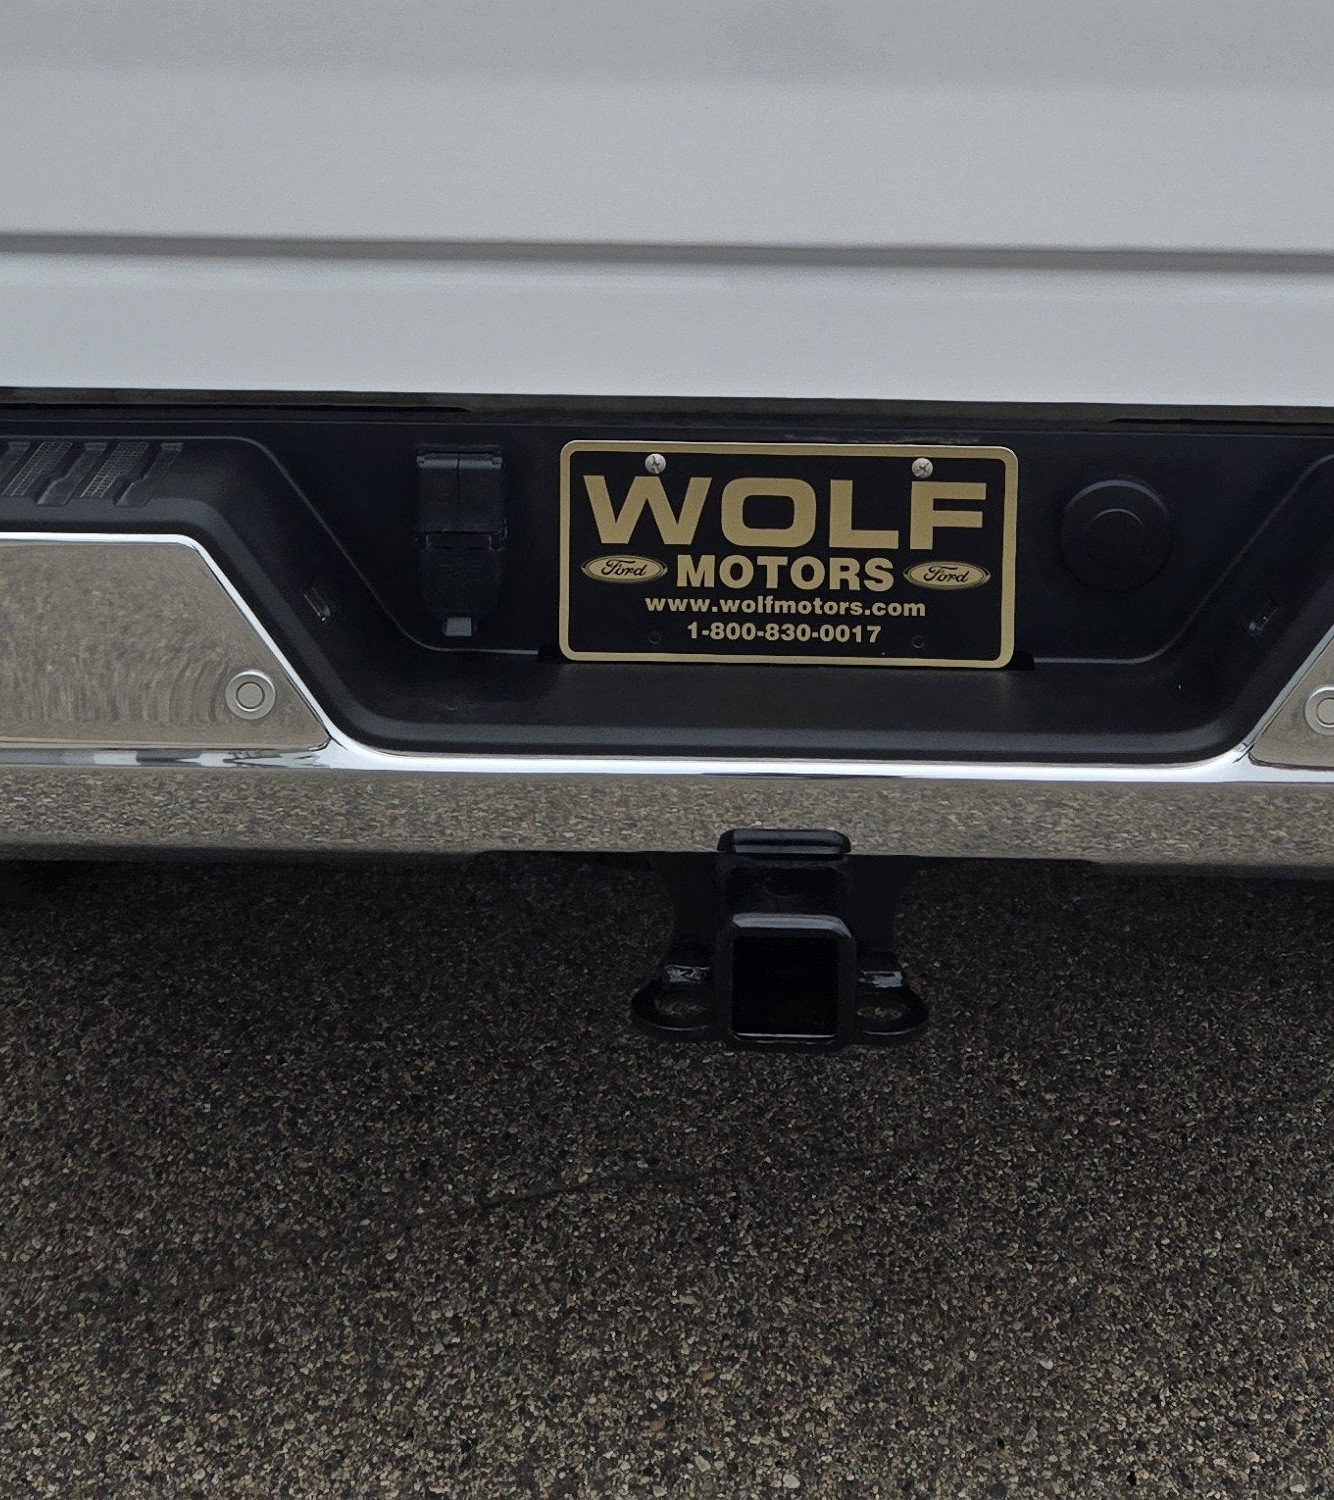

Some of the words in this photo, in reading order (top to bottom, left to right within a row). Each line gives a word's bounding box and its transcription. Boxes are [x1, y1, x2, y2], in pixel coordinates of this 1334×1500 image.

[583, 475, 987, 550] WOLF
[599, 559, 647, 577] Ford
[676, 554, 894, 591] MOTORS
[923, 565, 970, 584] Ford
[645, 596, 926, 617] www.wolfmotors.com
[687, 622, 882, 643] 1-800-830-0017
